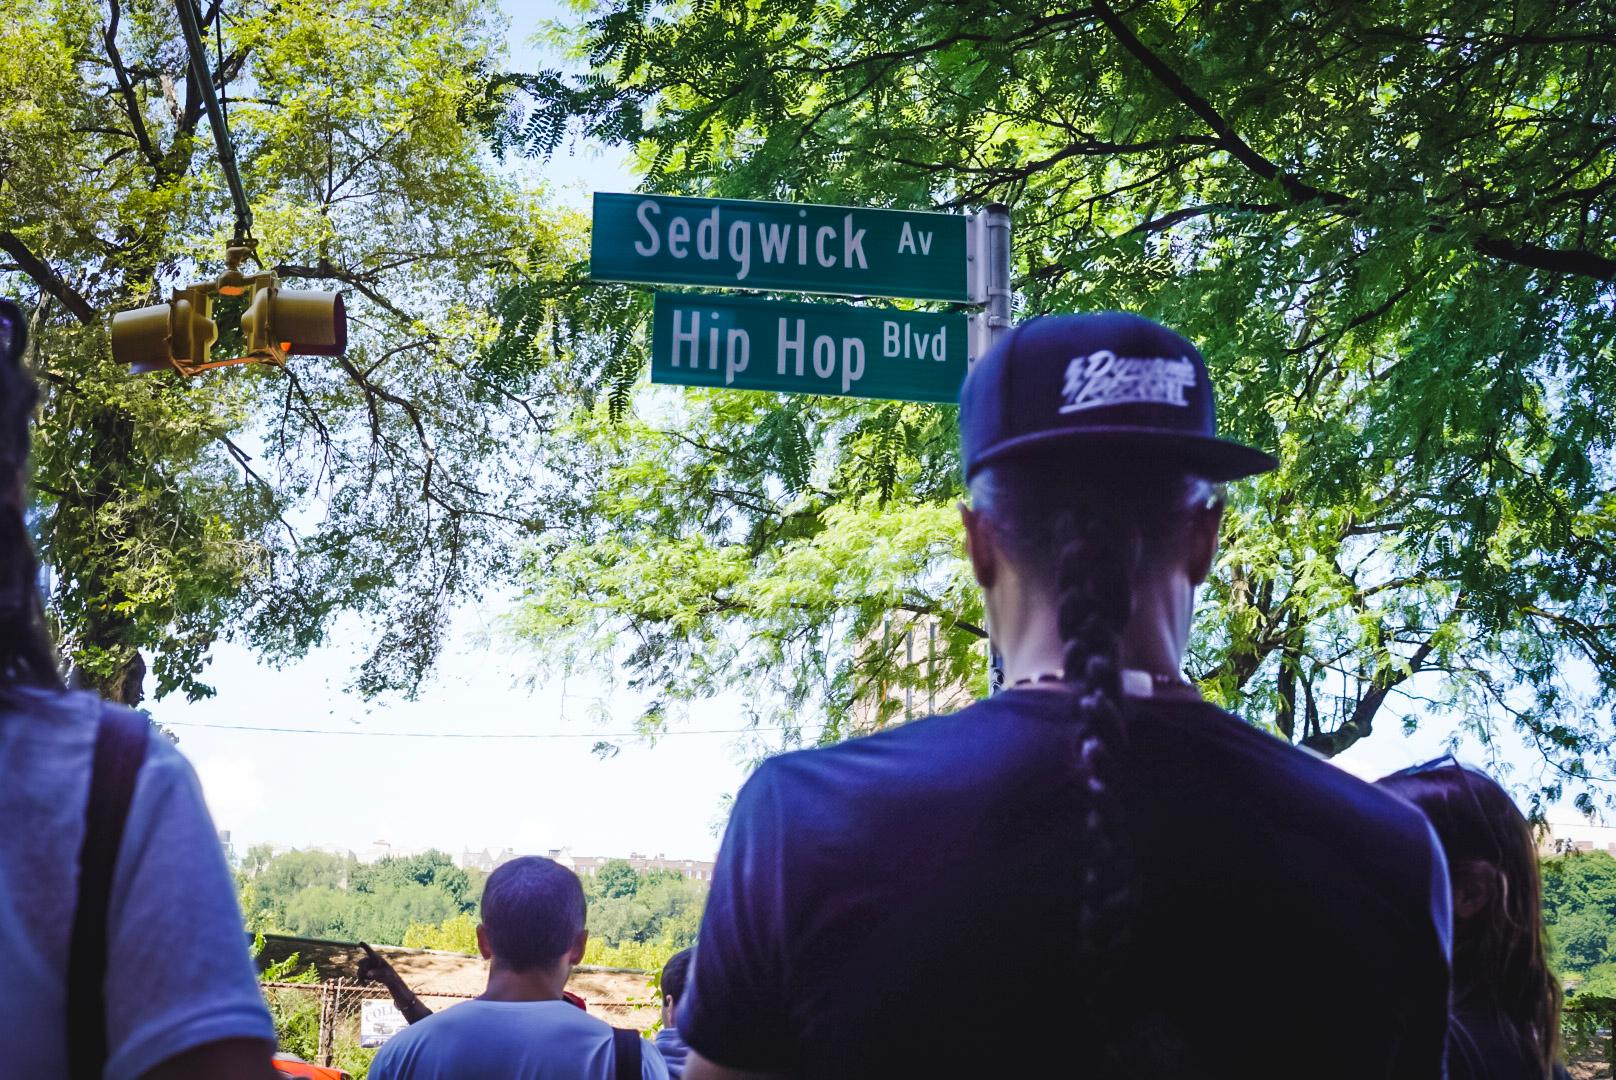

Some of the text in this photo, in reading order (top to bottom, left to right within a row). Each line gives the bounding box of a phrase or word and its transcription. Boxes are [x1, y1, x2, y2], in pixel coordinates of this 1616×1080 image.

[633, 200, 934, 280] Sedgwick Av
[671, 309, 946, 393] Hip Hop Blvd
